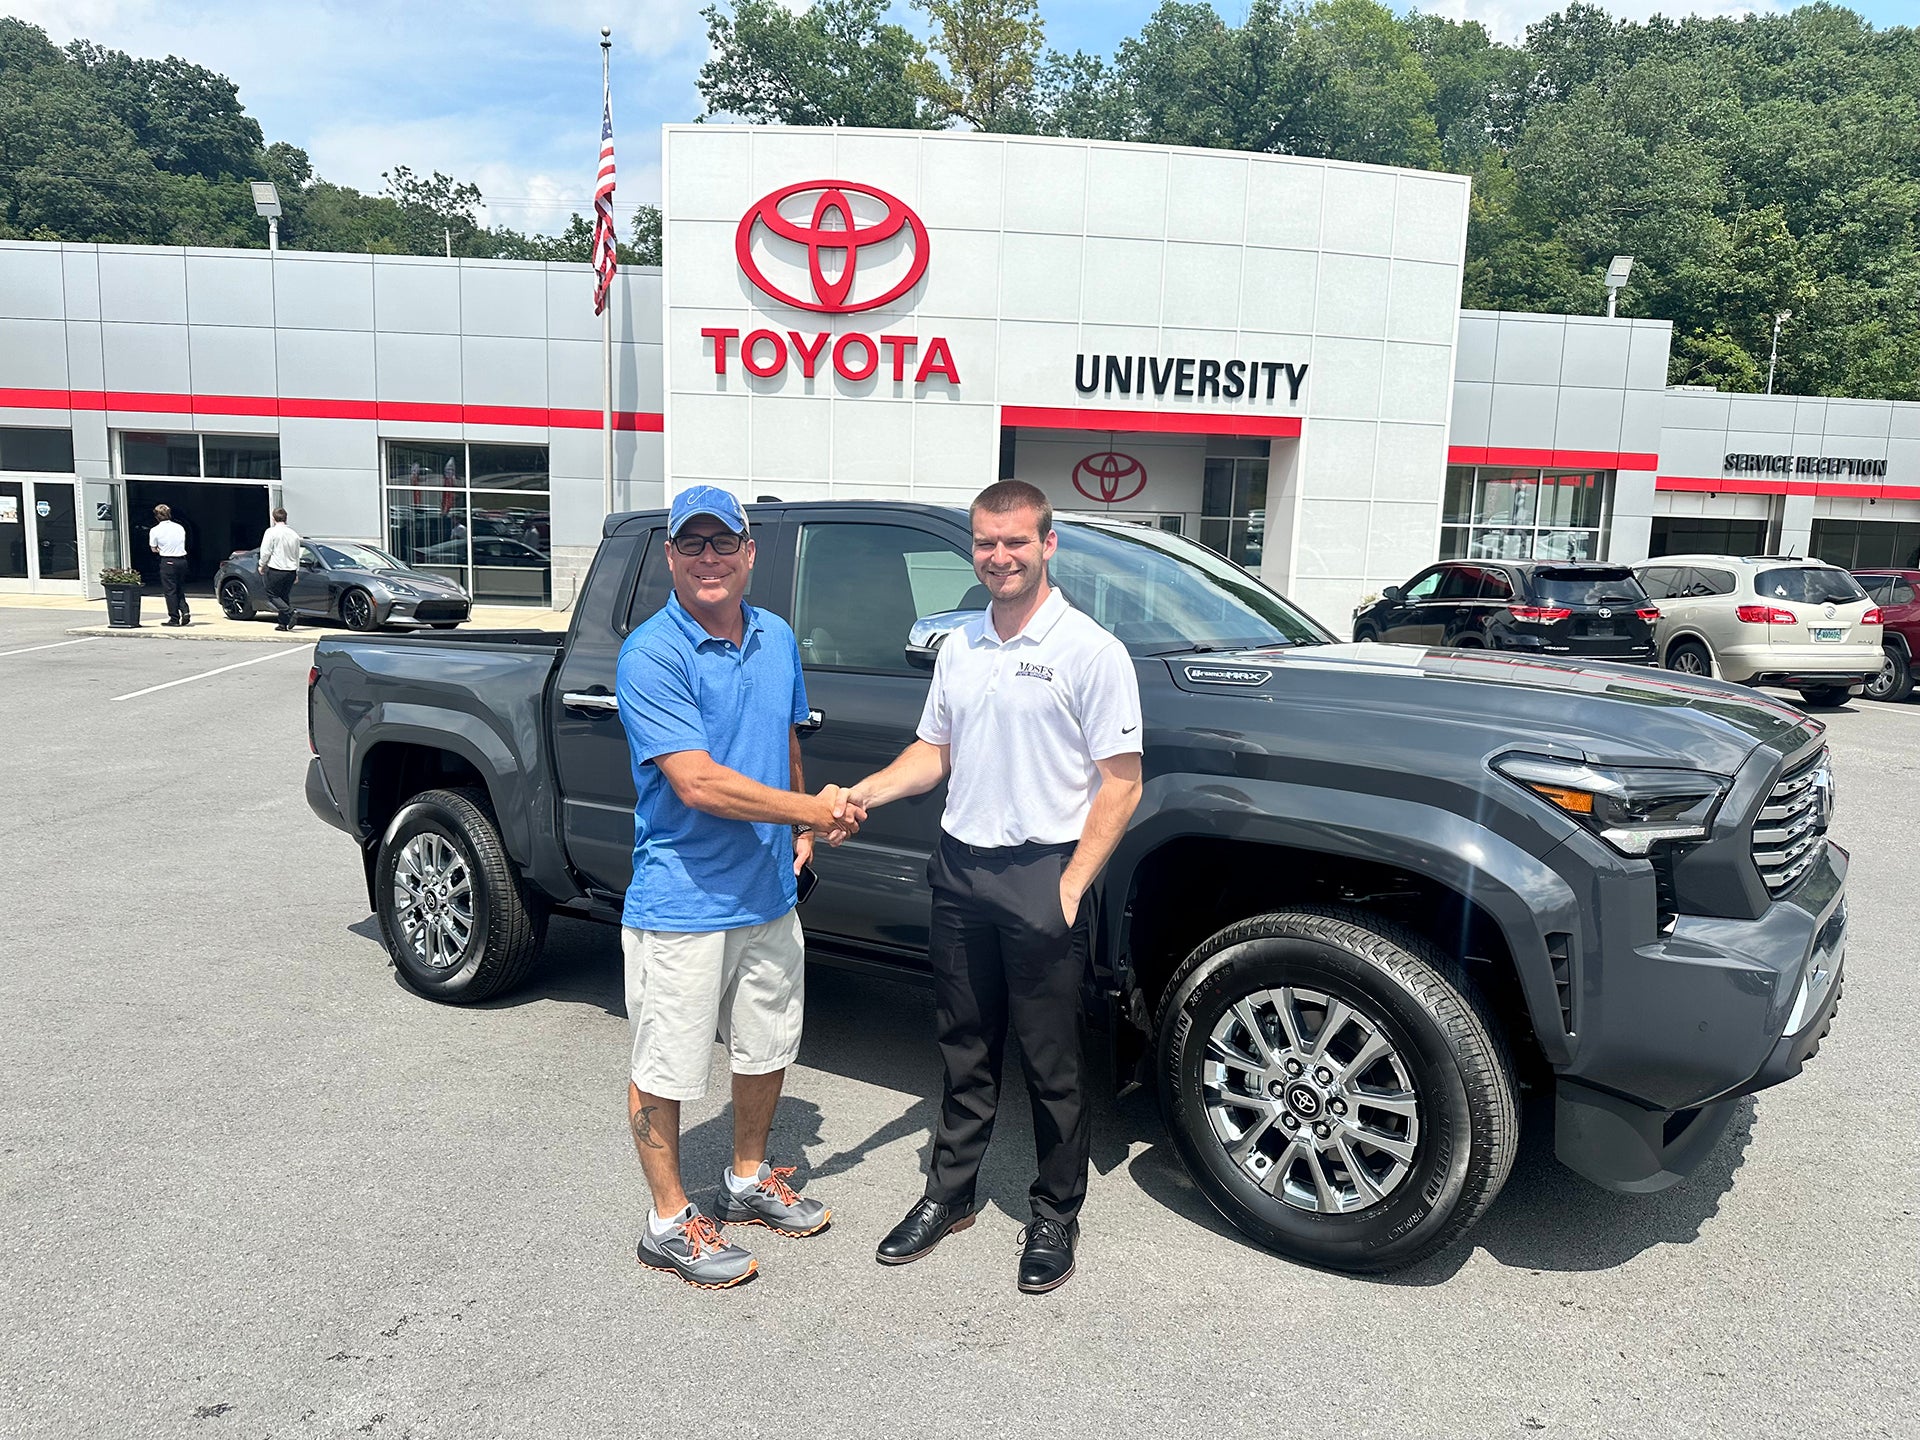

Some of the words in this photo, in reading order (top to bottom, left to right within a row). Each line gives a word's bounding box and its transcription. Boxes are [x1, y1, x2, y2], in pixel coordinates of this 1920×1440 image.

[701, 328, 961, 384] TOYOTA
[1075, 354, 1309, 400] UNIVERSITY
[1724, 453, 1793, 472] SERVICE
[1796, 456, 1887, 476] RECEPTION
[1020, 661, 1054, 677] MOSES
